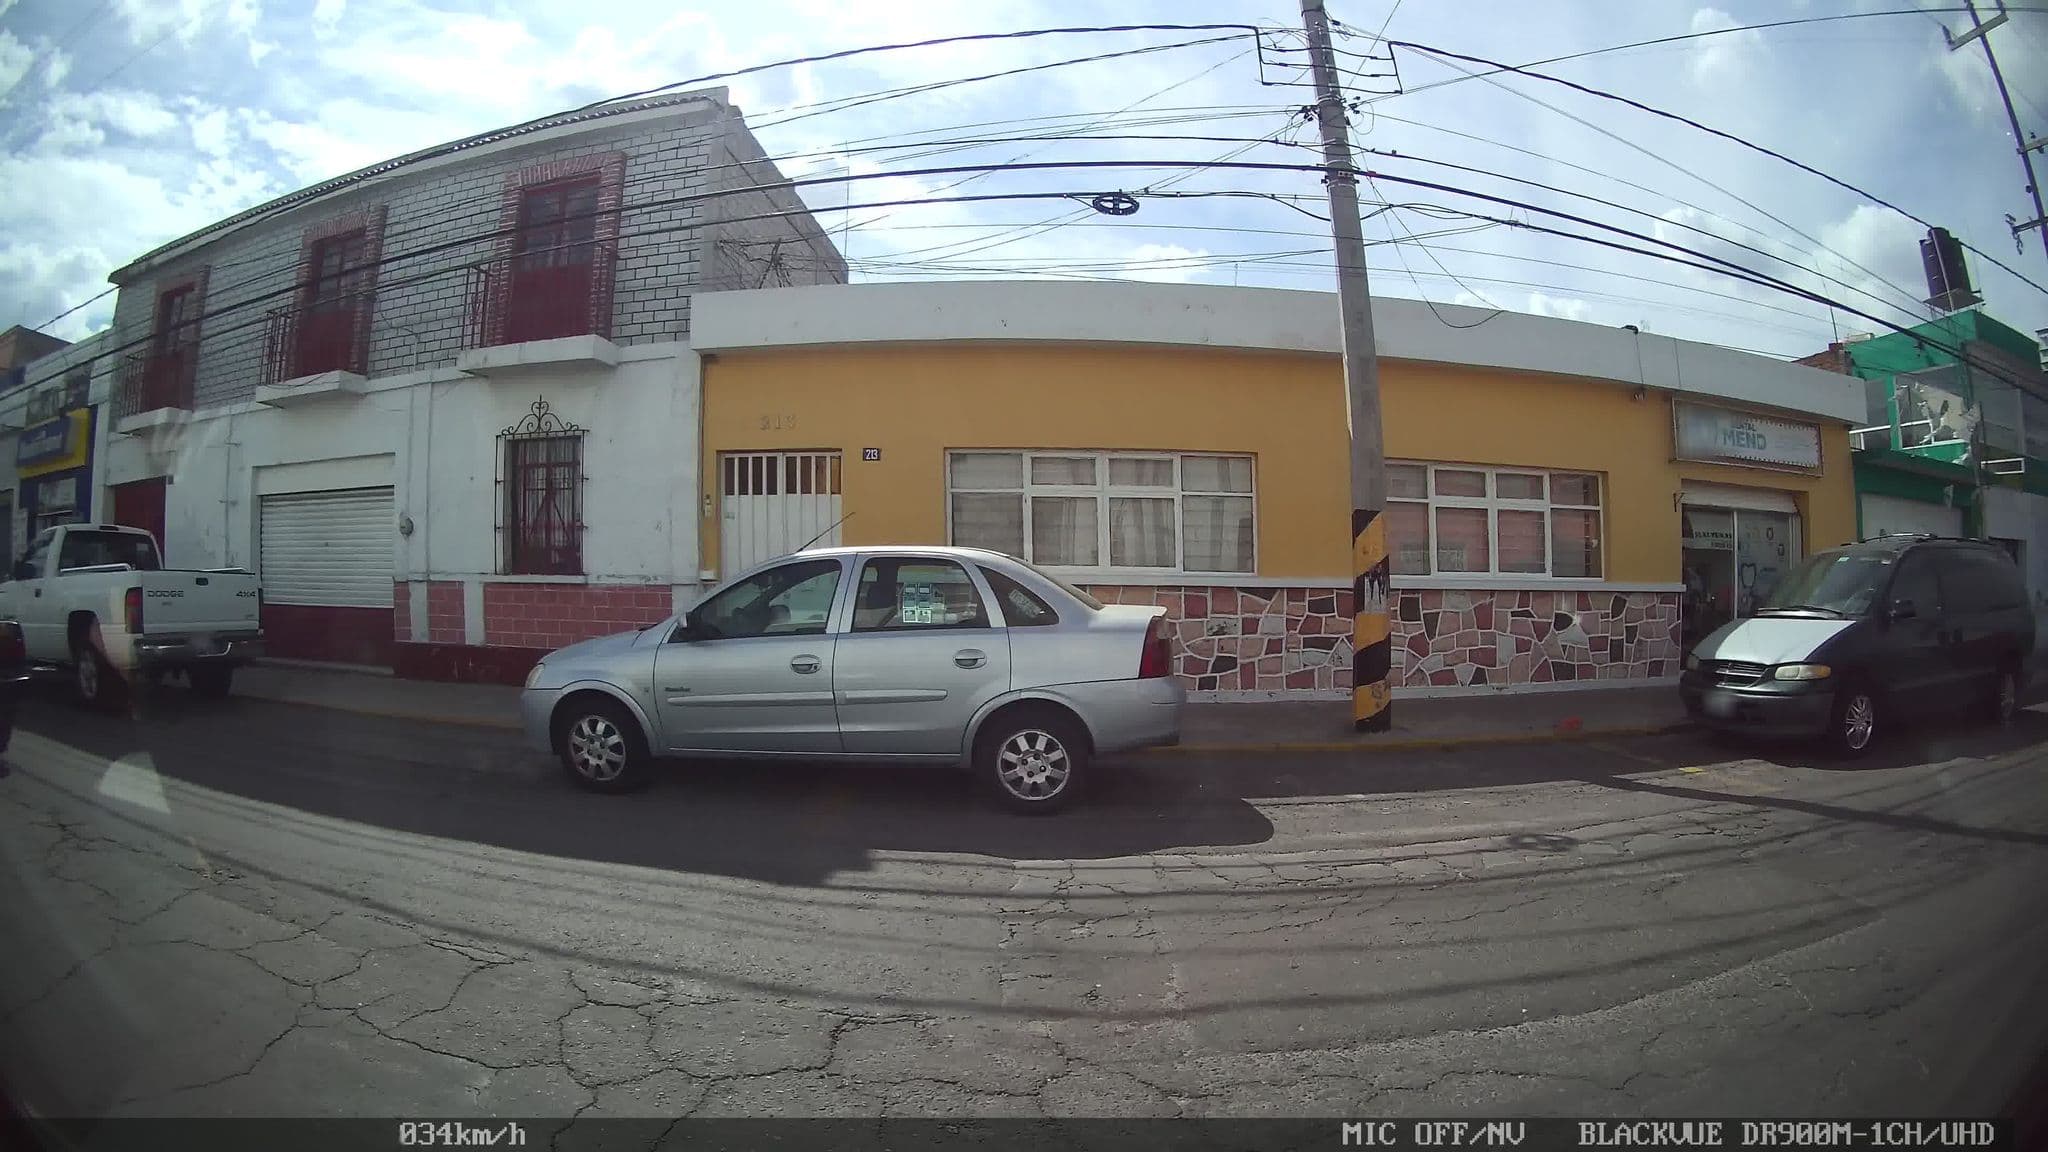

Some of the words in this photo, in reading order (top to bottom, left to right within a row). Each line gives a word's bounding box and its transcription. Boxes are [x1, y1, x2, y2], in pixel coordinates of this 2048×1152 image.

[1723, 427, 1768, 450] MEND
[865, 449, 879, 460] 213
[147, 590, 184, 598] DODGE
